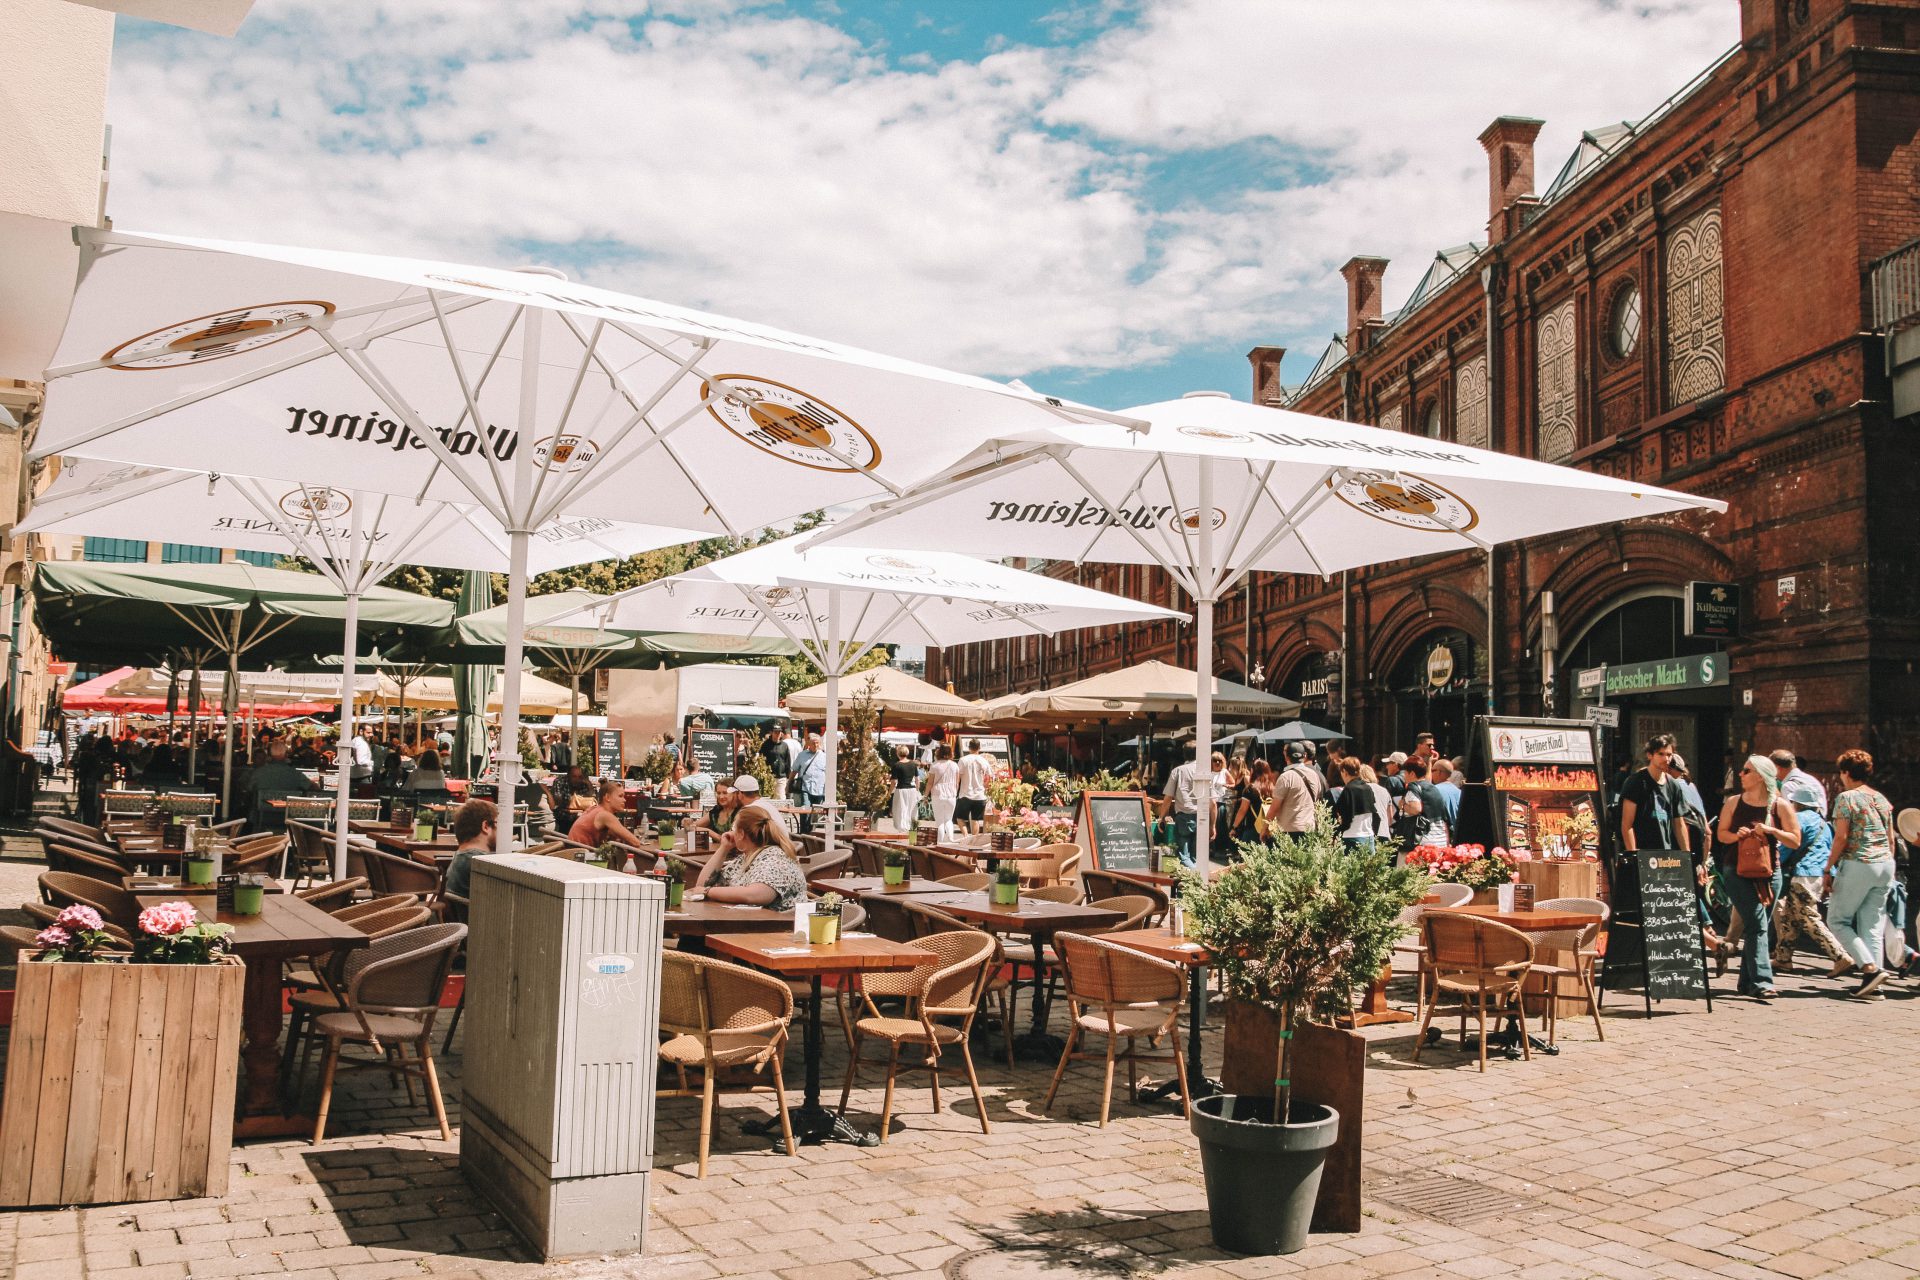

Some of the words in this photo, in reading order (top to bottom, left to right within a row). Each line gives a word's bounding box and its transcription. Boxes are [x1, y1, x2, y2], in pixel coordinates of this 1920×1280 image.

[1696, 603, 1736, 615] Kilkenny
[1656, 663, 1687, 686] Markt
[1702, 657, 1714, 682] S
[1525, 740, 1548, 754] Berliner
[1548, 734, 1564, 749] Kindl
